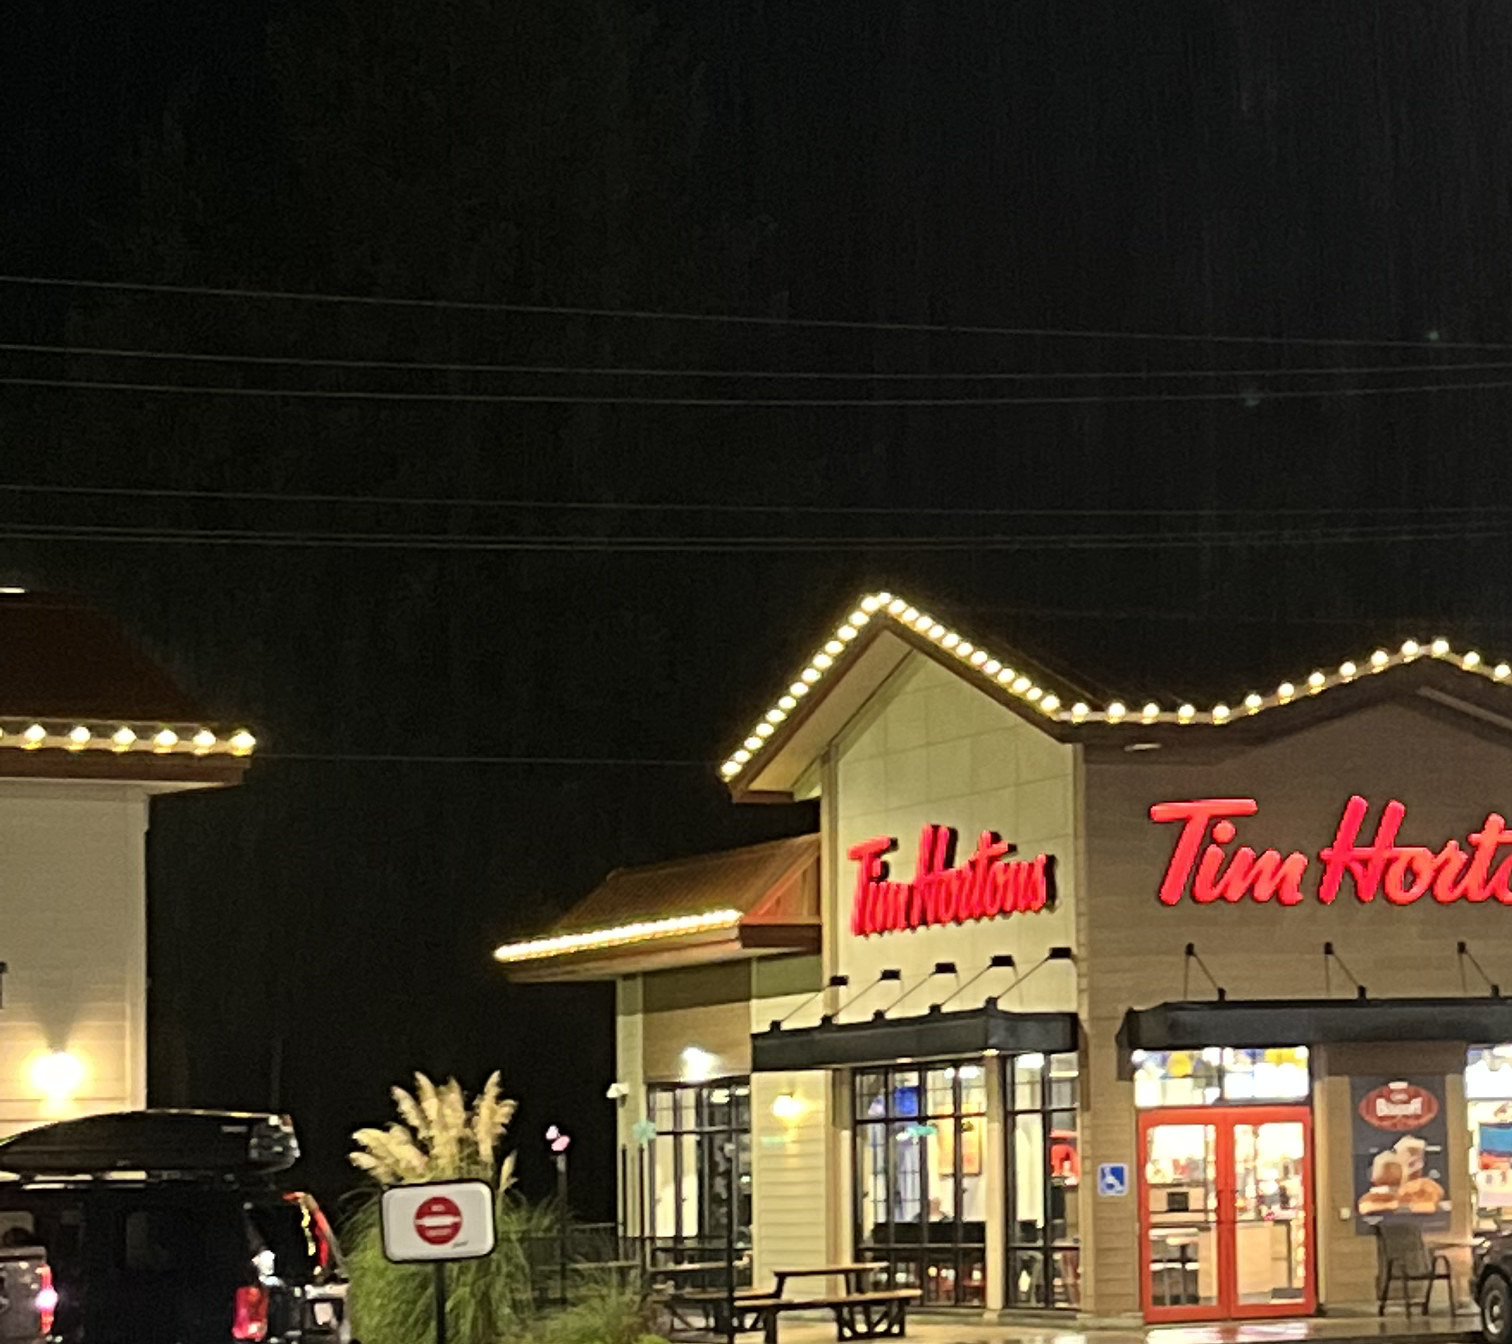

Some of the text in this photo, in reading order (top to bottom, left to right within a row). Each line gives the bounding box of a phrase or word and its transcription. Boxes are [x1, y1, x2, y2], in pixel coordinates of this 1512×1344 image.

[848, 823, 1048, 937] Tim Hortons
[1149, 798, 1309, 906] Tim
